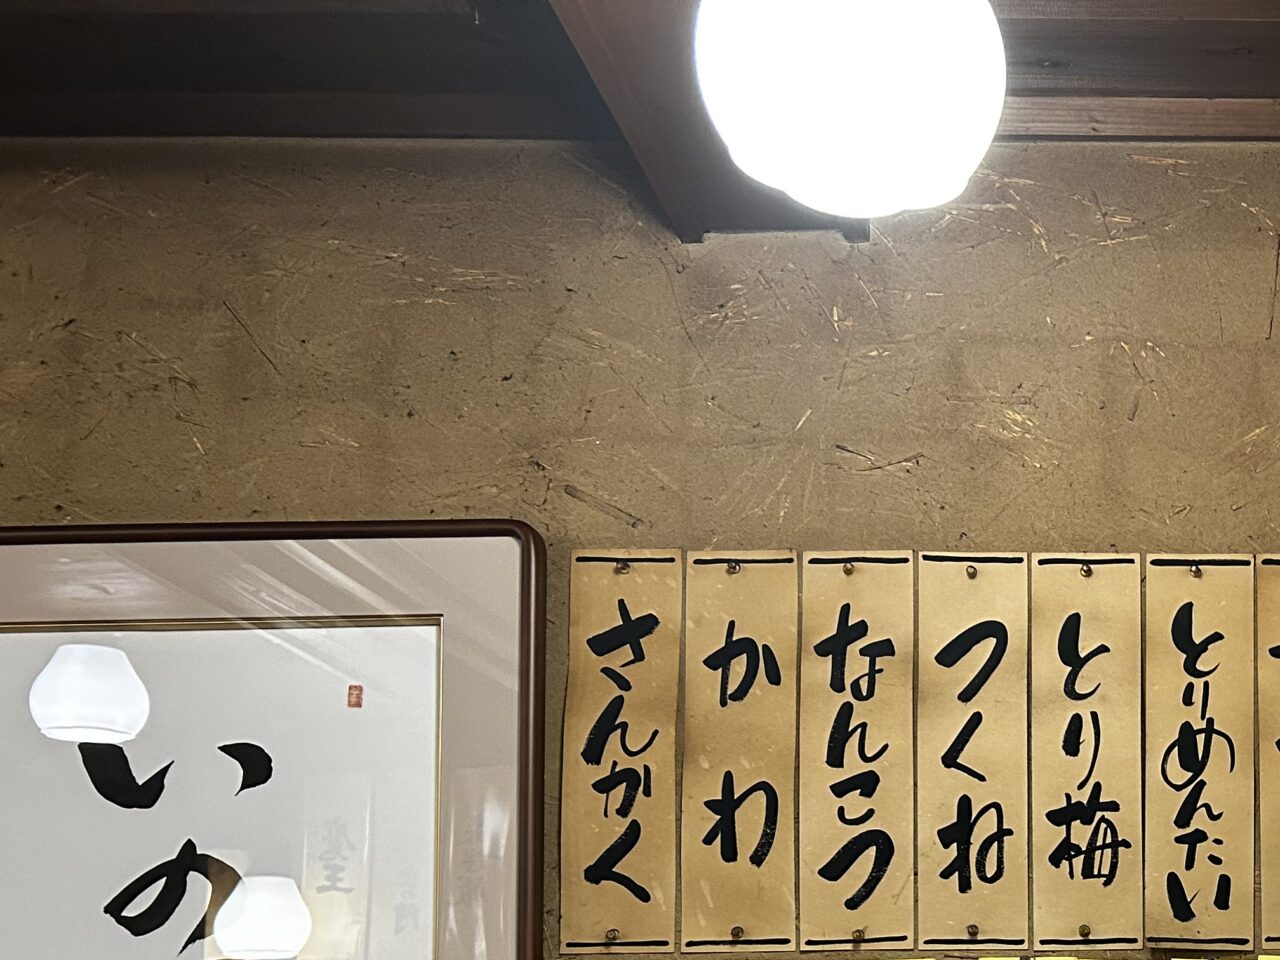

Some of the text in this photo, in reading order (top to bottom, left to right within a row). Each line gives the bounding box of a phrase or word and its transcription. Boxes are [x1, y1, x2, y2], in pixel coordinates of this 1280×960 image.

[581, 599, 660, 903] さんかく
[702, 620, 781, 868] かわ
[813, 603, 895, 910] なんこつ
[934, 620, 1014, 894] つくね
[1045, 612, 1132, 887] とり梅
[1161, 602, 1235, 922] とりめんたい
